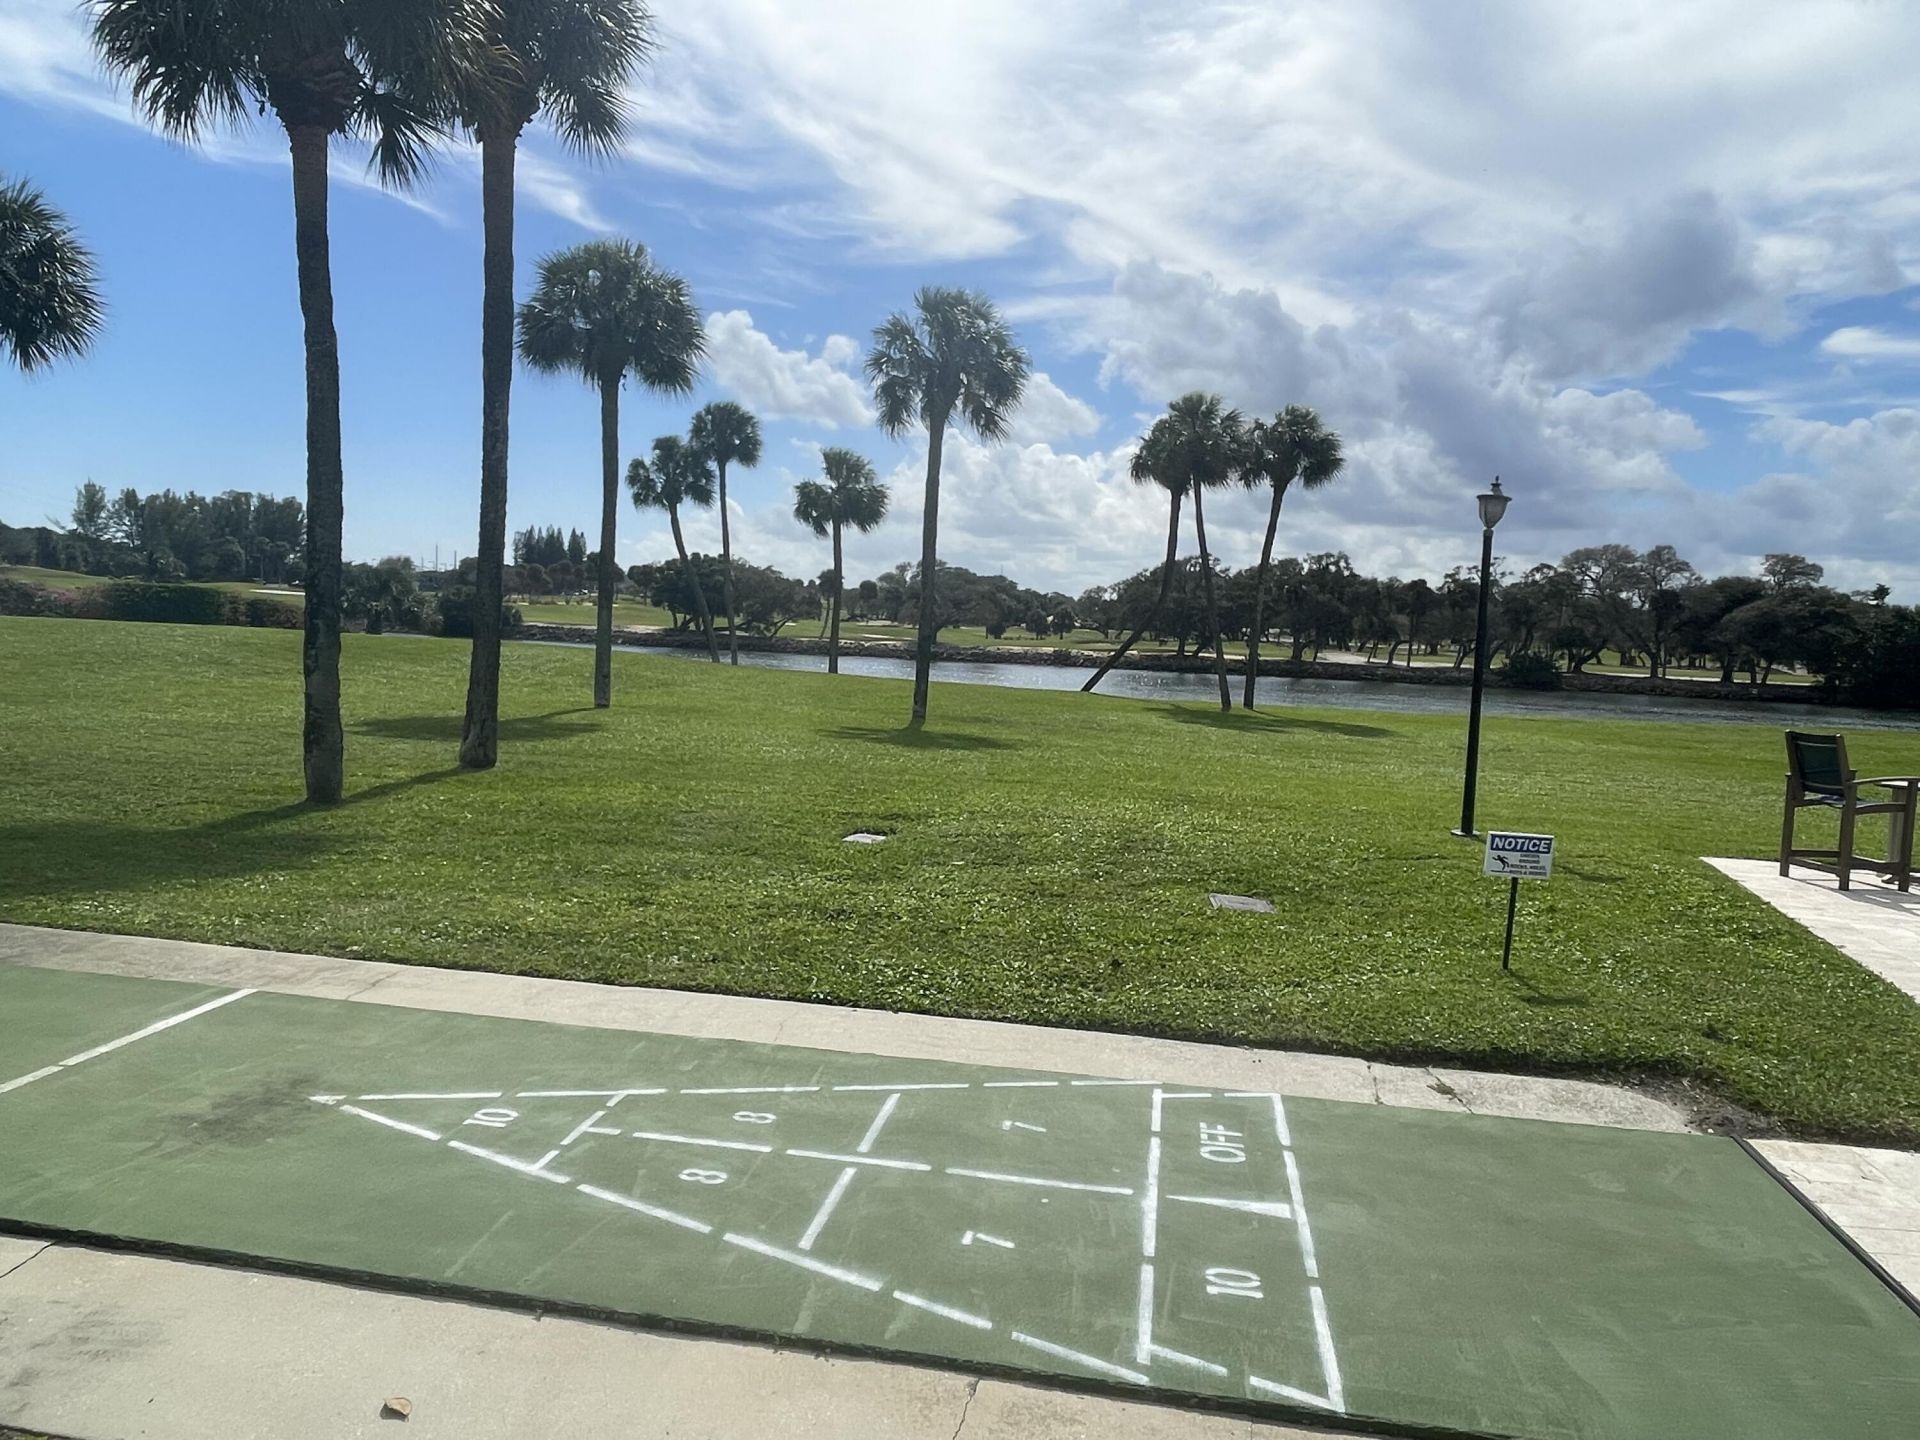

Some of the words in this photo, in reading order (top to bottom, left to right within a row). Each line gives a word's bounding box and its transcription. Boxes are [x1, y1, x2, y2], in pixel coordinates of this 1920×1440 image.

[1492, 837, 1550, 852] NOTICE
[462, 1108, 519, 1127] 10
[732, 1111, 777, 1124] 8
[1200, 1121, 1246, 1163] OFF
[678, 1168, 728, 1184] 8
[1205, 1267, 1264, 1299] 10
